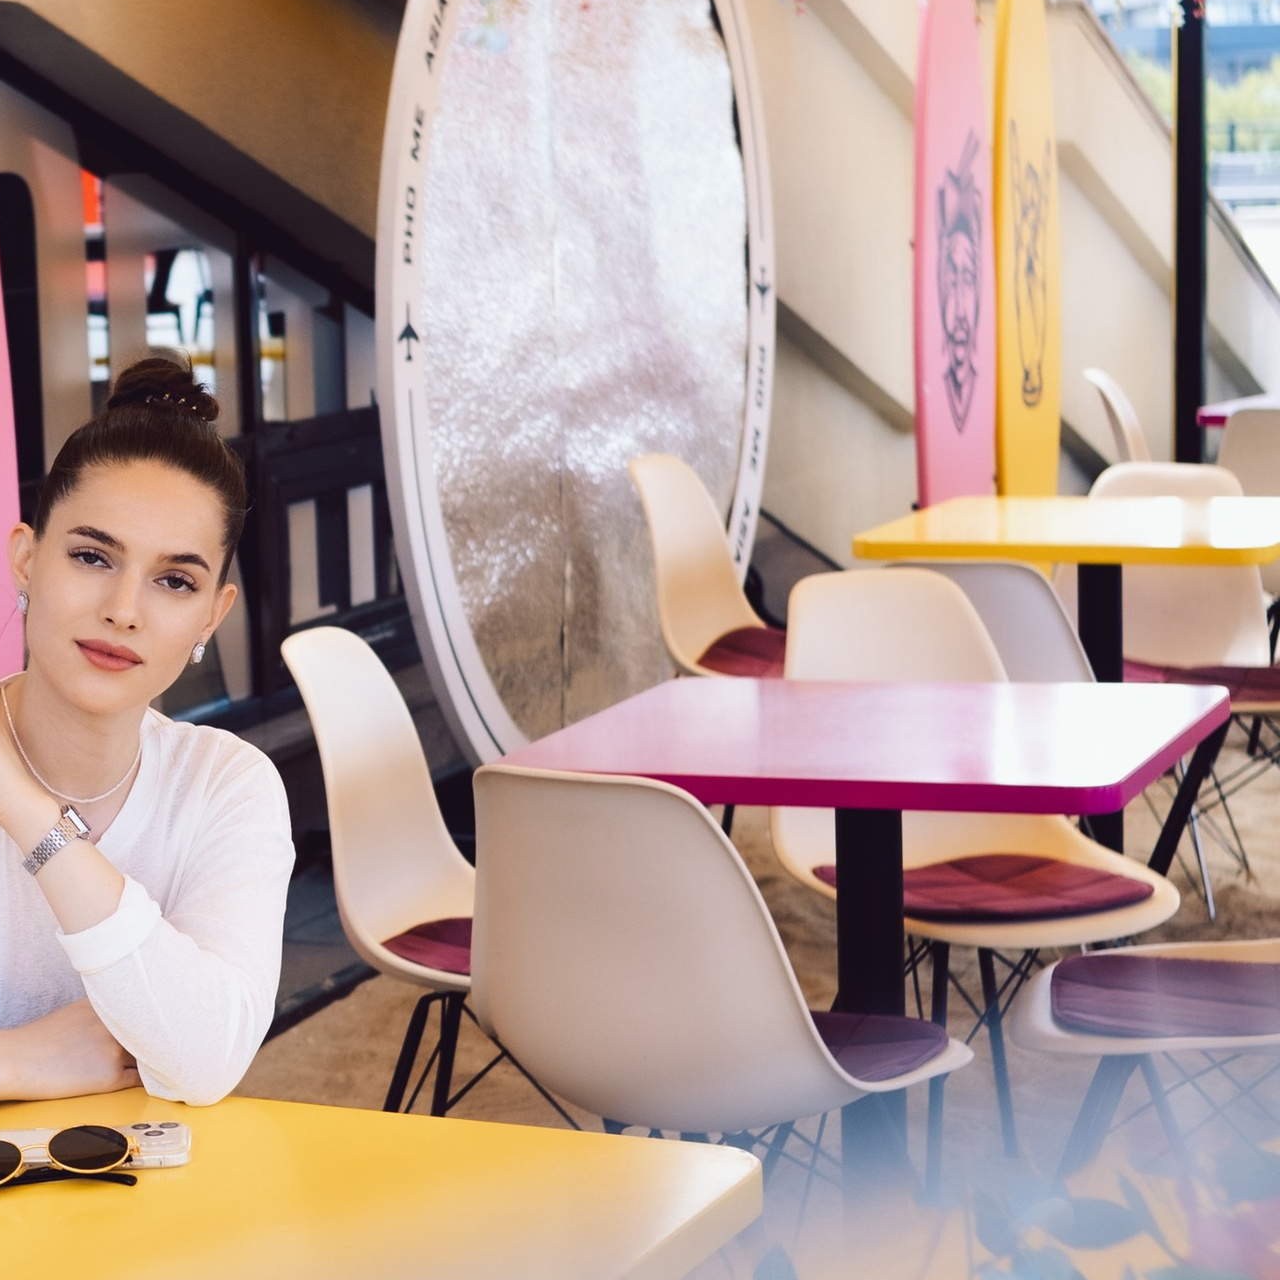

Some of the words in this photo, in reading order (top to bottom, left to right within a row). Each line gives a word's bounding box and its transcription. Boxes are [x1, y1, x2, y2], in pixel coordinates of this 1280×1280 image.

[402, 185, 416, 265] PHO
[409, 102, 426, 161] ME
[734, 499, 751, 564] ASIA
